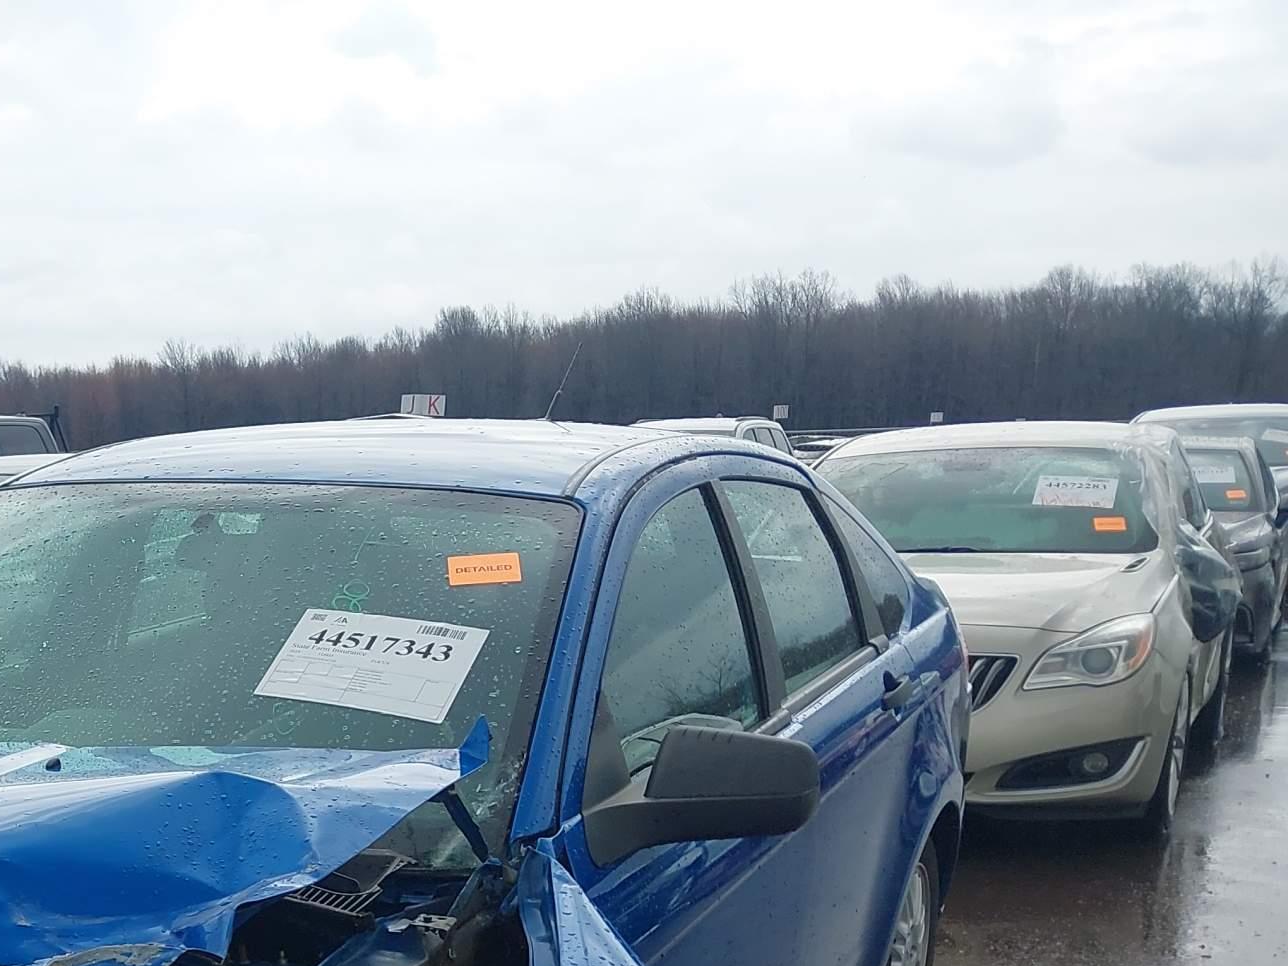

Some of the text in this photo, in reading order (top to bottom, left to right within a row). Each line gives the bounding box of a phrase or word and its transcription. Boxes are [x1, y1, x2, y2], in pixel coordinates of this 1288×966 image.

[428, 395, 440, 415] K
[455, 564, 513, 574] DETAILED
[308, 628, 454, 662] 44517343
[332, 647, 368, 657] Insurance
